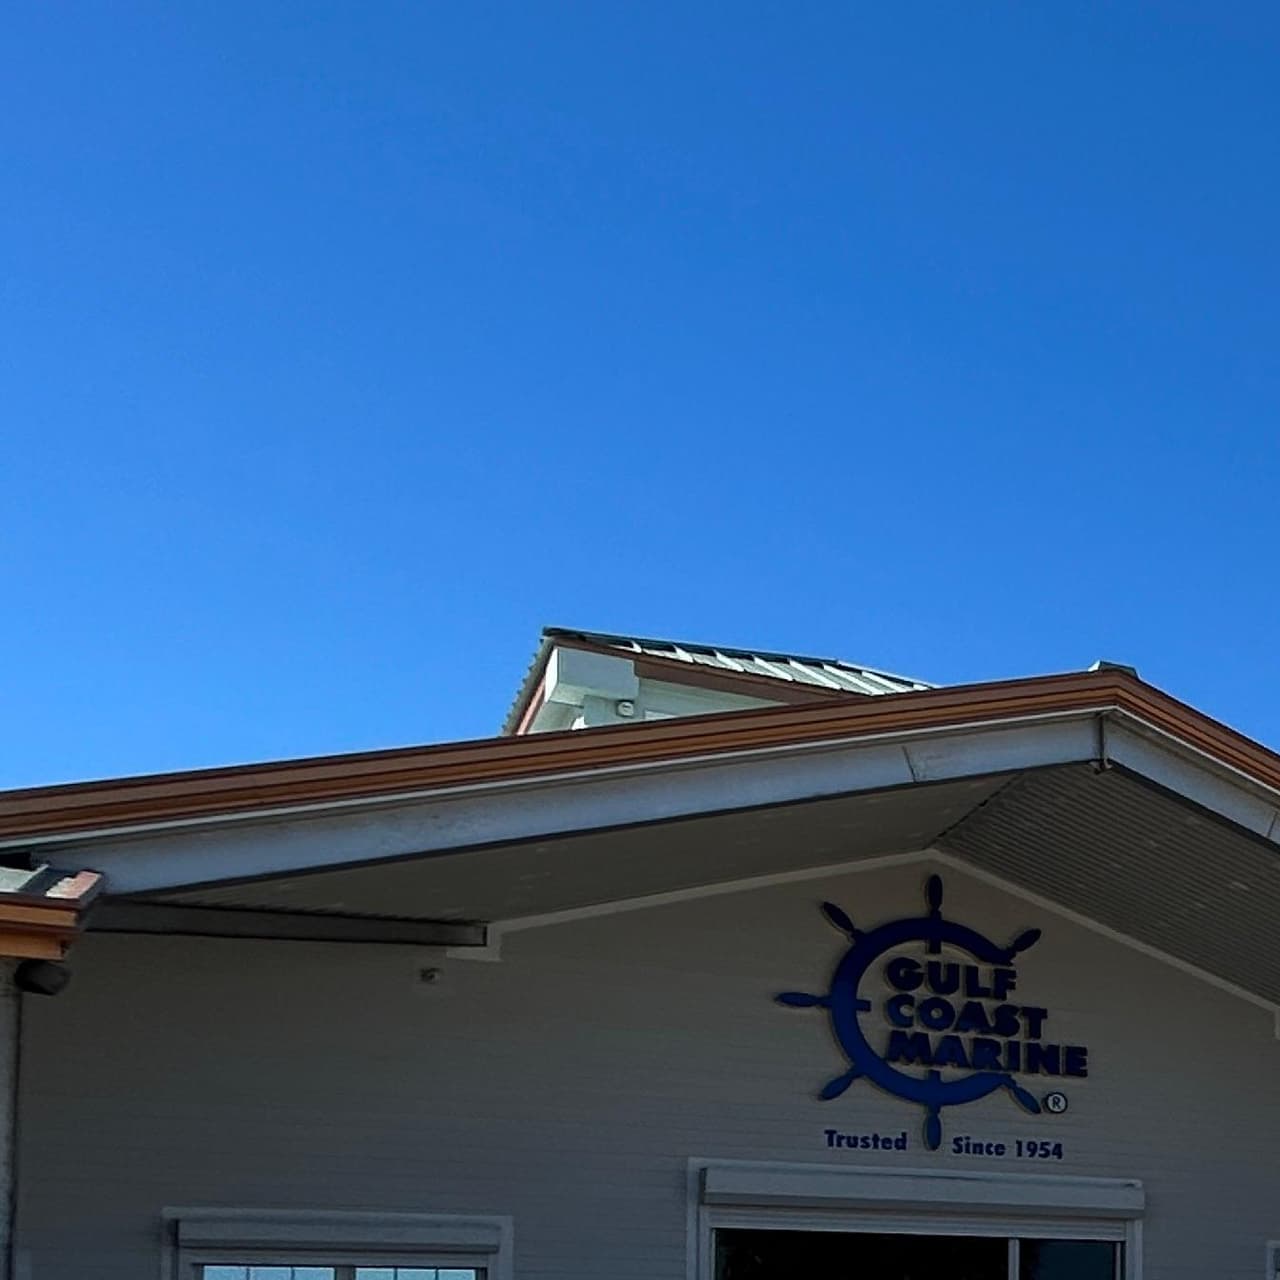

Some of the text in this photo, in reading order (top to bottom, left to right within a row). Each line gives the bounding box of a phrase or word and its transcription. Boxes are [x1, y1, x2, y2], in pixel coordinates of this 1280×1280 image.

[887, 957, 1017, 1000] GULF
[887, 994, 1048, 1039] COAST
[887, 1030, 1088, 1077] MARINE
[825, 1129, 1063, 1160] Trusted Since 1954
